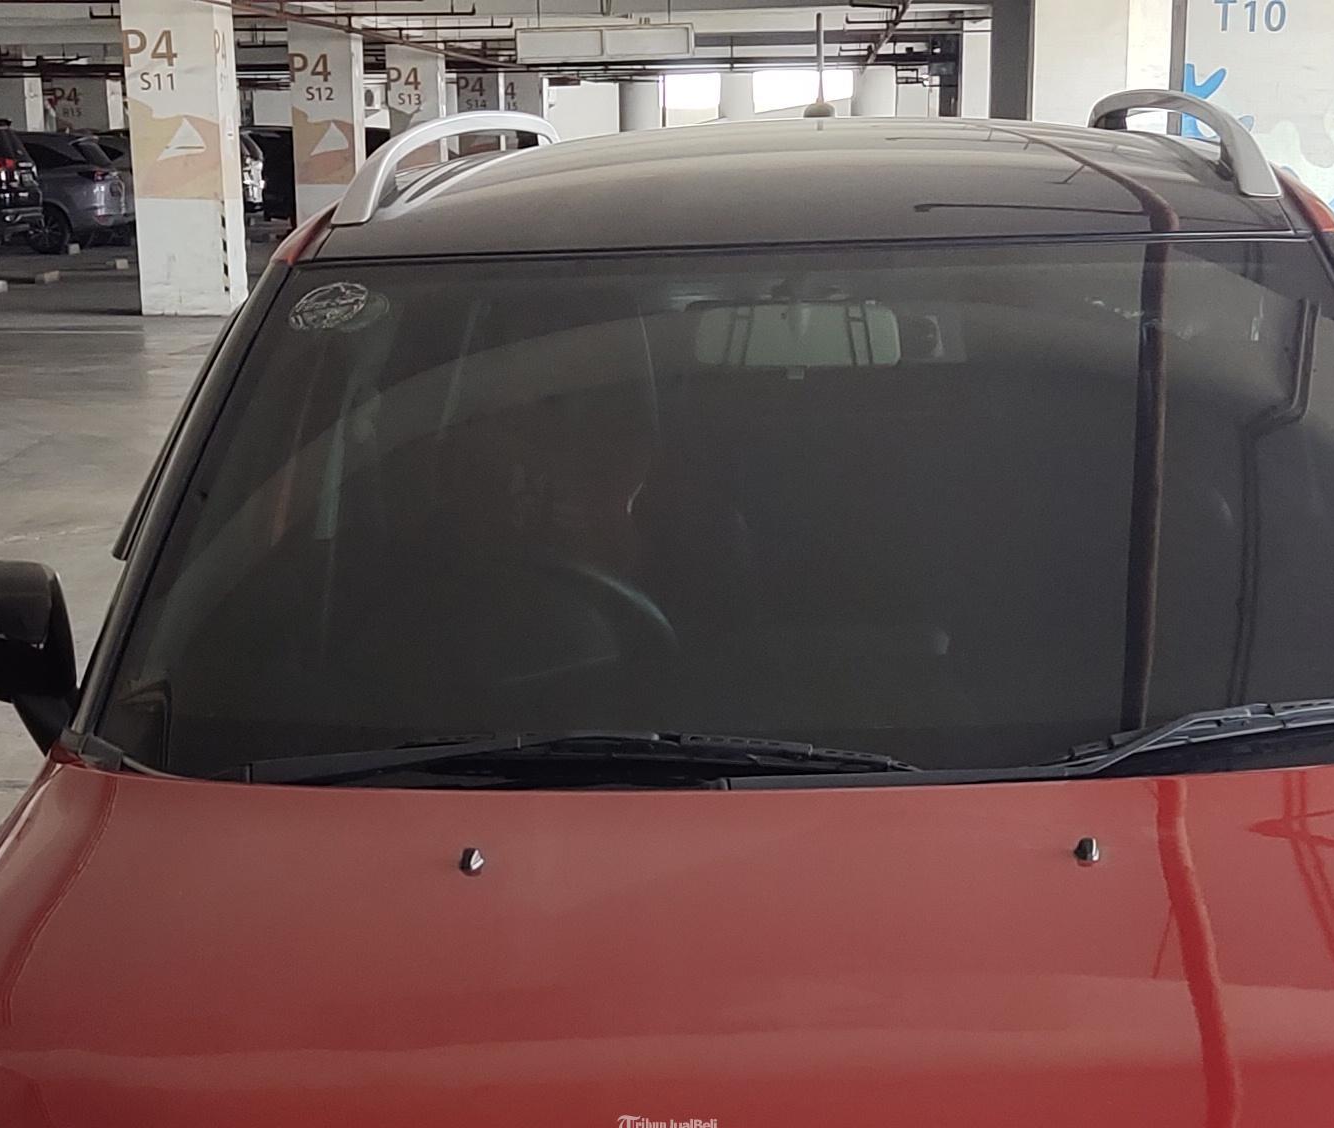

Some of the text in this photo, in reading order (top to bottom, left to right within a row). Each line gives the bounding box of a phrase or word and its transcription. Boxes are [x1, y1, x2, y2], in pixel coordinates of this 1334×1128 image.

[1214, 0, 1287, 32] T10
[122, 29, 178, 67] P4
[288, 53, 332, 82] P4
[140, 72, 175, 91] S11
[386, 67, 421, 91] P4
[457, 76, 486, 97] P4
[306, 86, 334, 101] S12
[398, 93, 422, 106] S13
